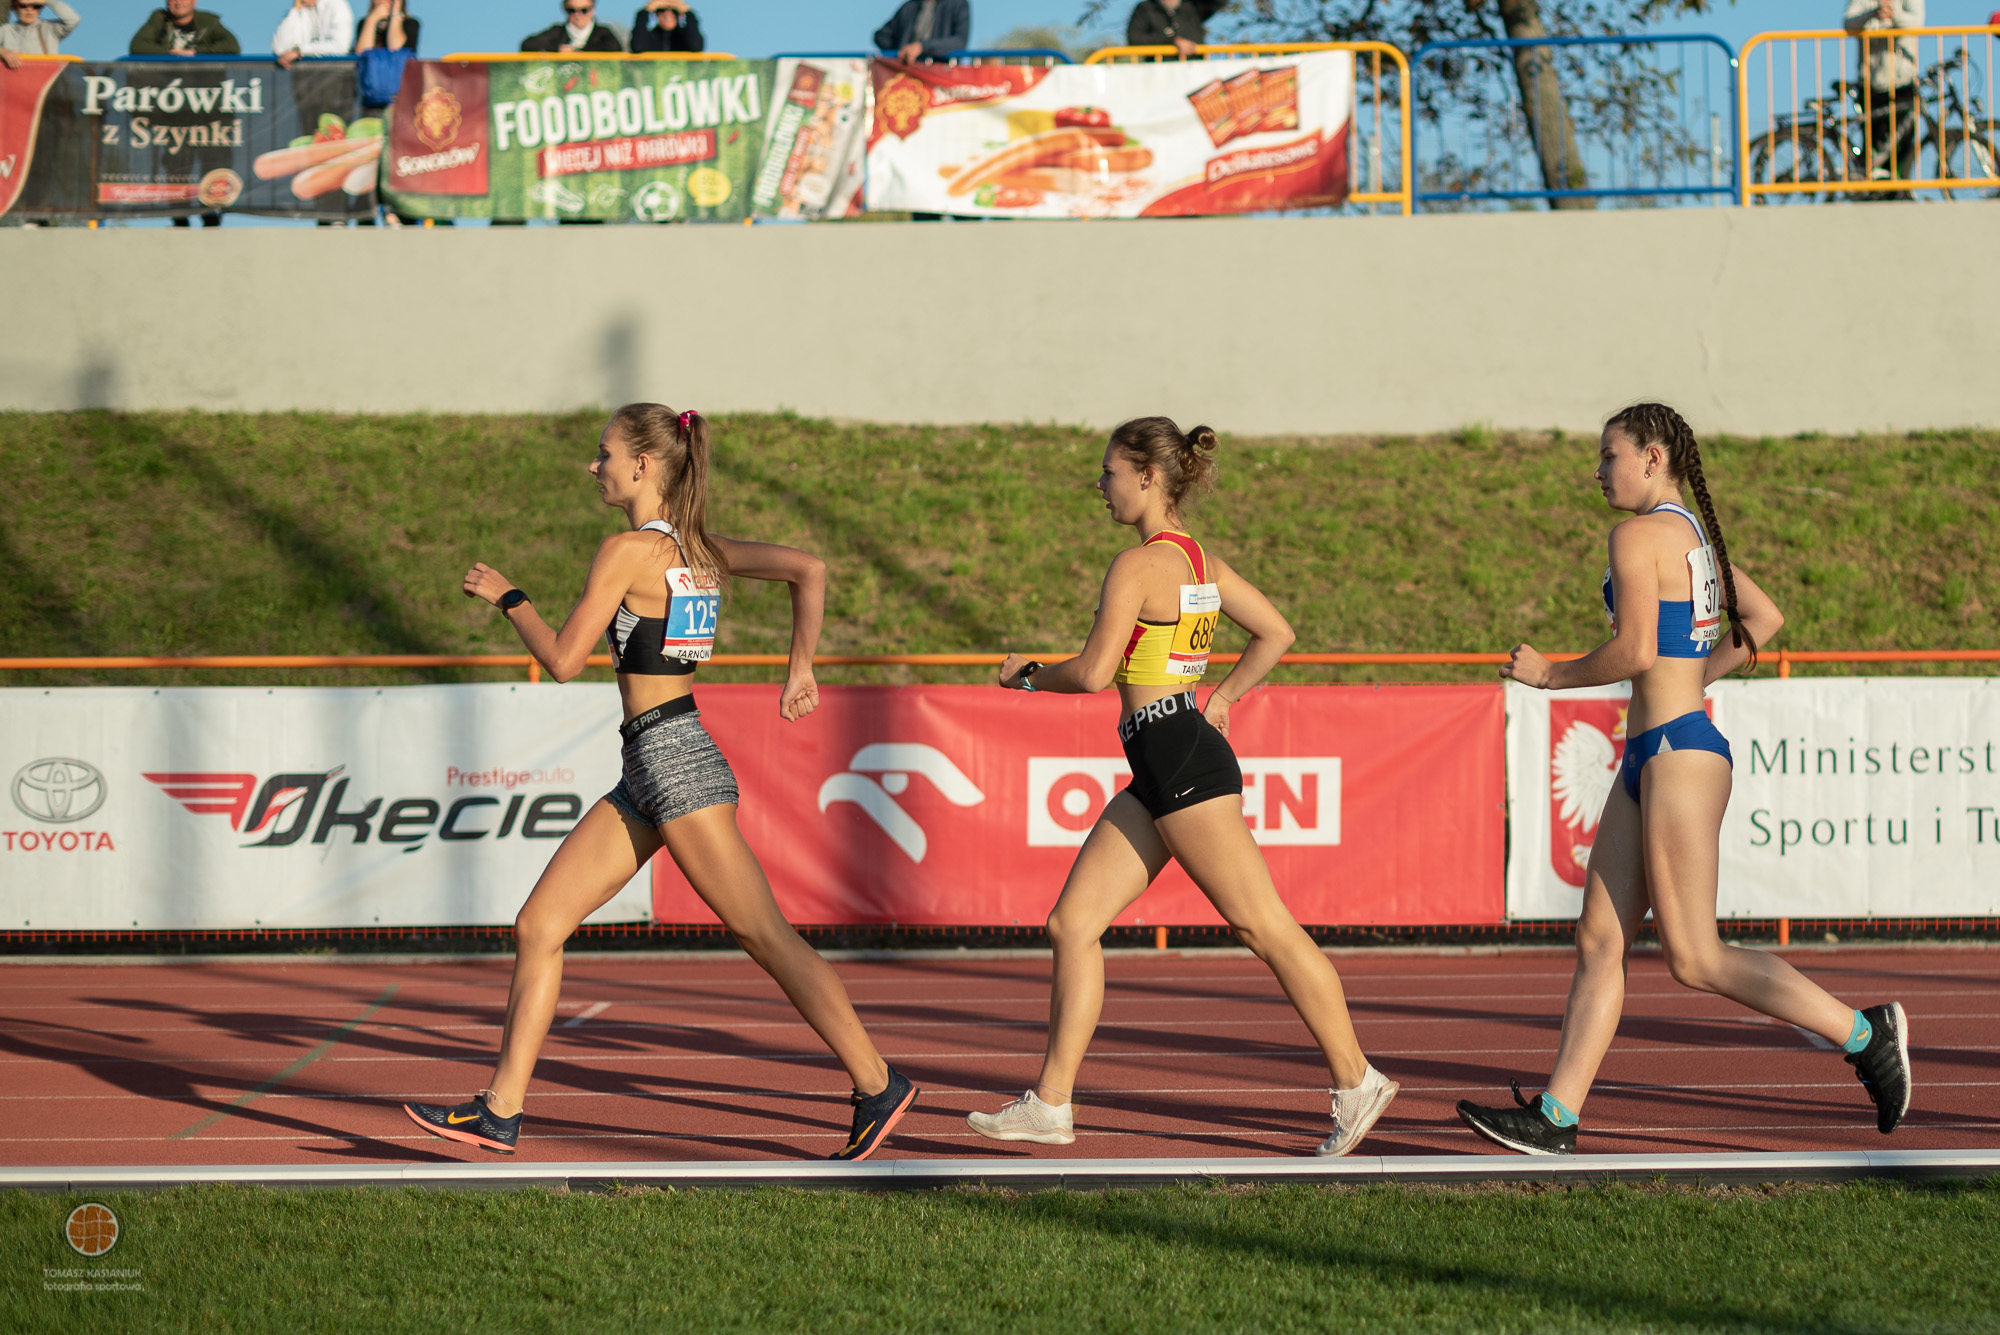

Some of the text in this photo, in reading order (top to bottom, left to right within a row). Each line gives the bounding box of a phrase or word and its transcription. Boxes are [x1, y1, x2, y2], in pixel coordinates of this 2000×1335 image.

[81, 75, 263, 116] Parówki
[493, 73, 761, 151] FOODBOLÓWKI
[102, 117, 243, 155] z Szynki
[684, 600, 717, 635] 125
[640, 709, 661, 727] PRO
[1133, 695, 1178, 730] PRO
[1750, 737, 1997, 775] Ministerst
[2, 831, 115, 851] TOYOTA
[1750, 808, 1908, 856] Sportu
[1935, 806, 1942, 844] i
